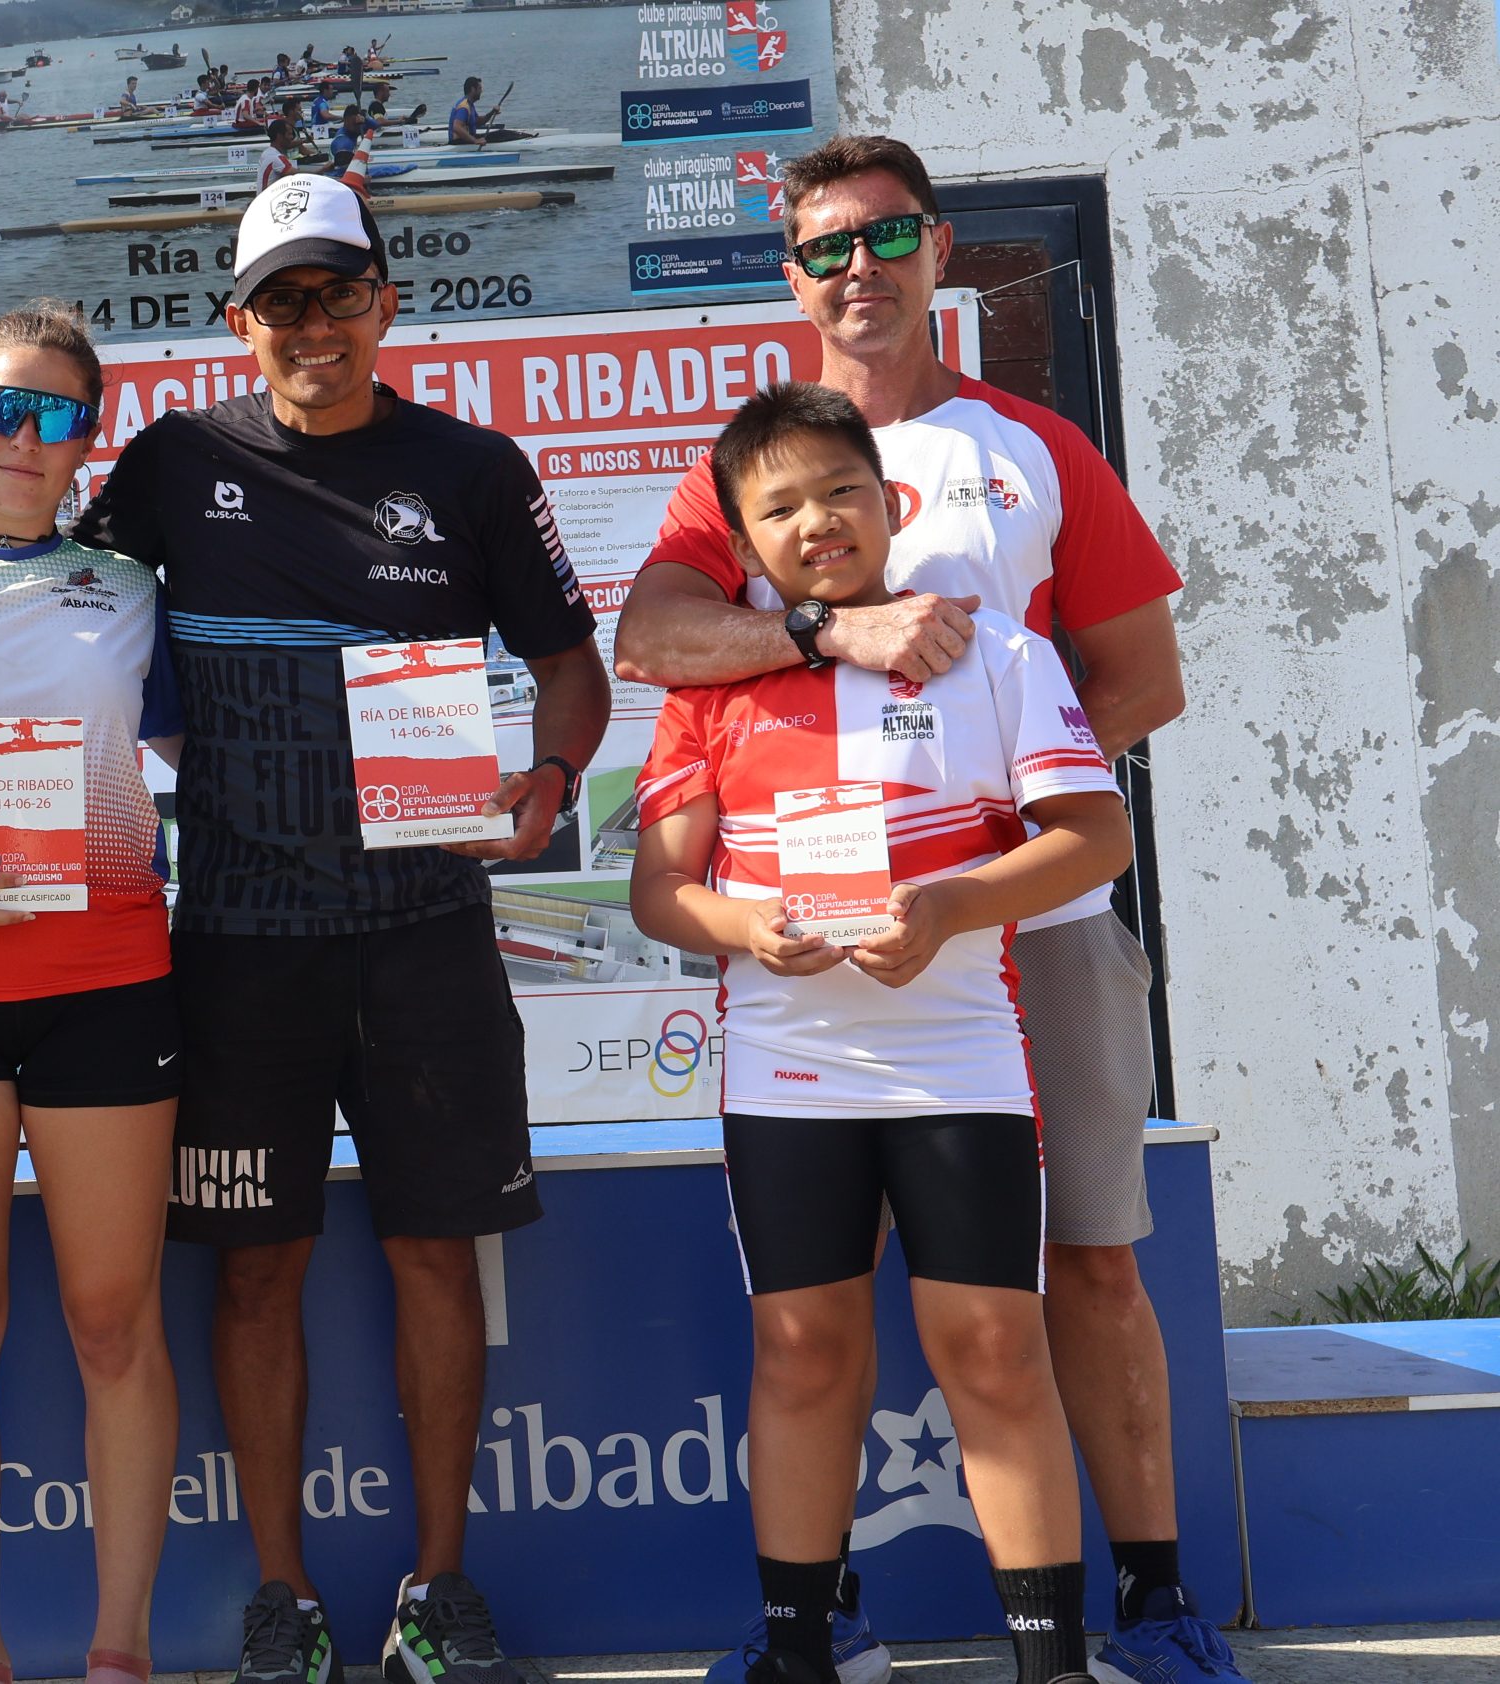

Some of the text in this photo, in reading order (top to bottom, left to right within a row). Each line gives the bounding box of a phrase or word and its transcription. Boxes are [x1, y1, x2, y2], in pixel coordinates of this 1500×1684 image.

[638, 1, 722, 27] clube piragüismo
[639, 21, 725, 61] ALTRUÁN
[639, 59, 726, 79] ribadeo
[652, 103, 670, 112] COPA
[768, 100, 805, 112] Deportes
[697, 109, 713, 117] LUGO
[644, 153, 732, 181] clube piragüismo
[204, 192, 223, 202] 124
[646, 172, 735, 215] ALTRUÁN
[646, 210, 736, 231] ribadeo
[128, 242, 200, 277] Ría
[661, 254, 680, 263] COPA
[707, 258, 723, 266] LUGO
[131, 292, 190, 330] DE
[430, 273, 532, 313] 2026
[411, 339, 792, 429] EN RIBADEO
[548, 448, 641, 475] OS NOSOS
[558, 488, 589, 498] Esforzo
[598, 484, 644, 497] Superación
[559, 502, 614, 512] Colaboración
[205, 510, 253, 522] austral
[560, 516, 613, 527] Compromiso
[560, 531, 601, 542] Igualdade
[564, 545, 598, 555] nclusión
[607, 541, 656, 552] Diversidade
[360, 703, 479, 723] RÍA DE RIBADEO
[753, 714, 816, 735] RIBADEO
[390, 724, 455, 740] 14-06-26
[883, 729, 934, 742] ribadeo
[17, 778, 74, 791] RIBADEO
[401, 784, 430, 796] COPA
[402, 793, 458, 806] DEPUTACIÓN
[460, 793, 472, 803] DE
[404, 803, 476, 817] DE PIRAGÜISMO
[404, 825, 484, 838] CLUBE CLASIFICADO
[786, 831, 877, 849] RÍA DE RIBADEO
[2, 853, 26, 863] COPA
[808, 847, 859, 860] 14-06-26
[2, 862, 82, 872] DEPUTACIÓN DE LUGO
[21, 894, 71, 902] CLASIFICADO
[816, 893, 838, 902] COPA
[860, 898, 870, 906] DE
[817, 909, 827, 918] DE
[302, 1446, 391, 1521] de
